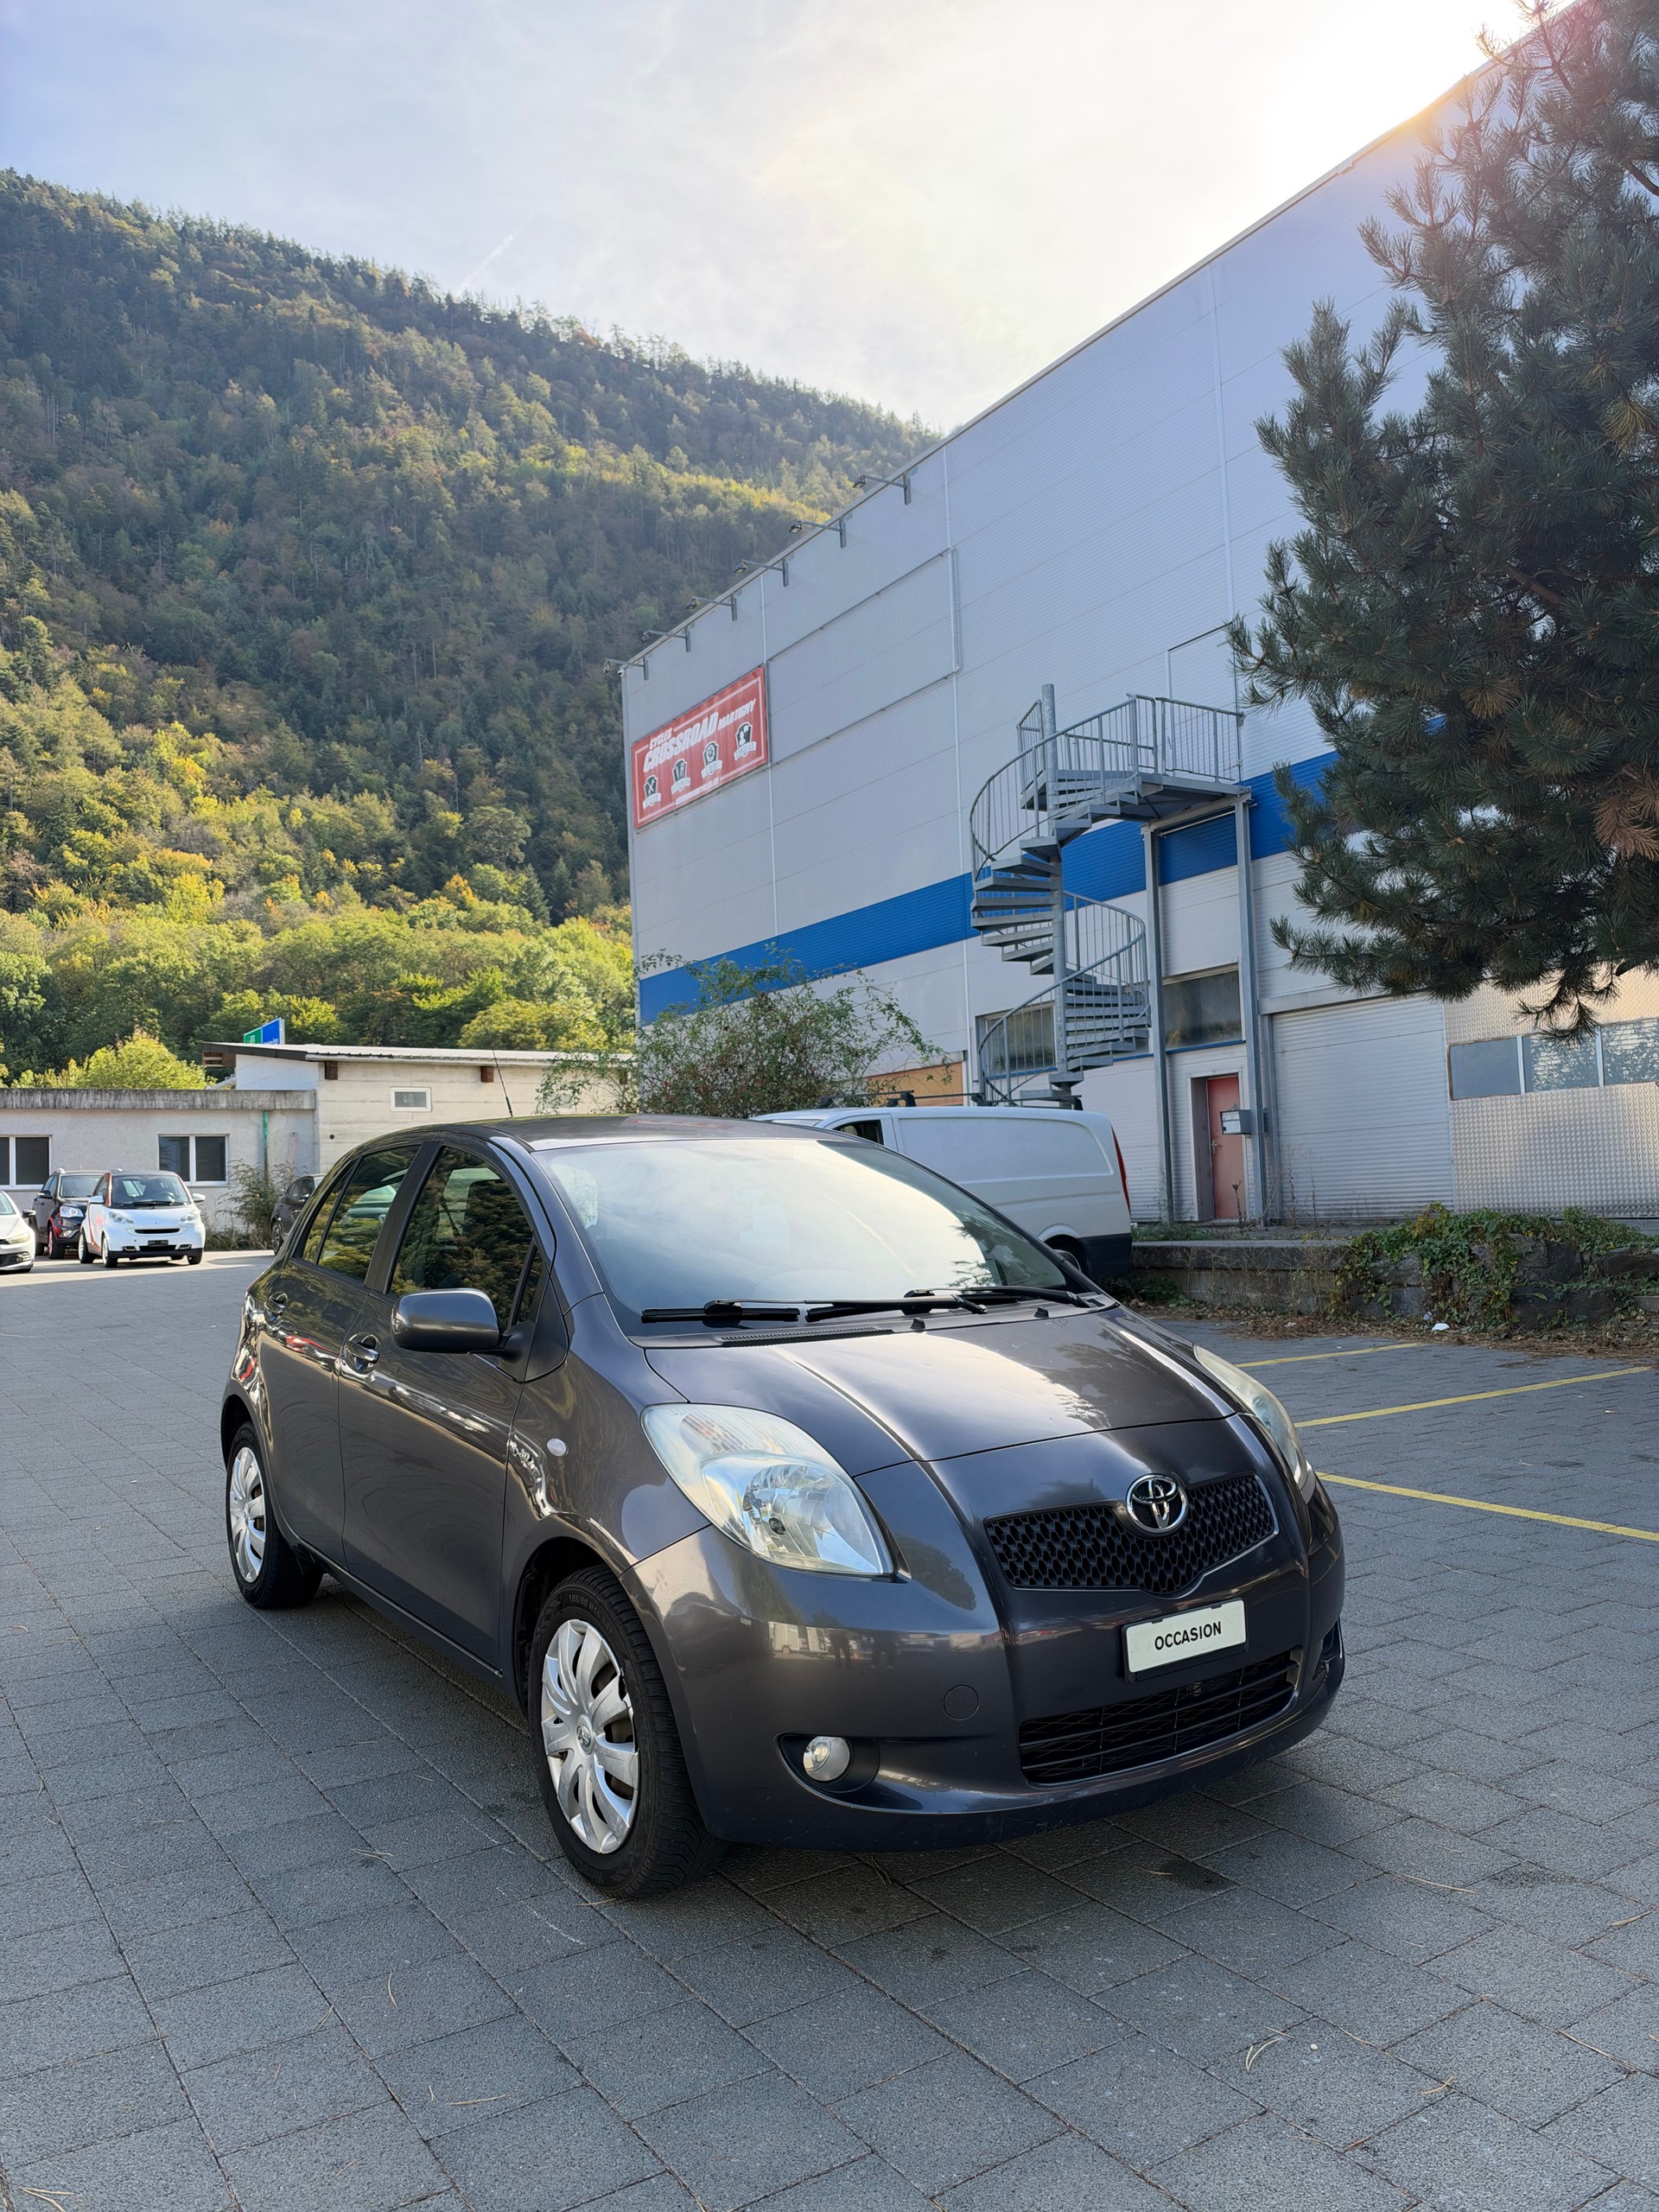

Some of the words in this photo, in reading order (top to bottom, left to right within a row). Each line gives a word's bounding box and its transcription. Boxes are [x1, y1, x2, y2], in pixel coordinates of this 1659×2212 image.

[643, 711, 719, 773] CROSSROAD
[717, 698, 756, 731] MARTIGNY
[649, 728, 672, 750] CYCLES
[1154, 1621, 1222, 1650] OCCASION
